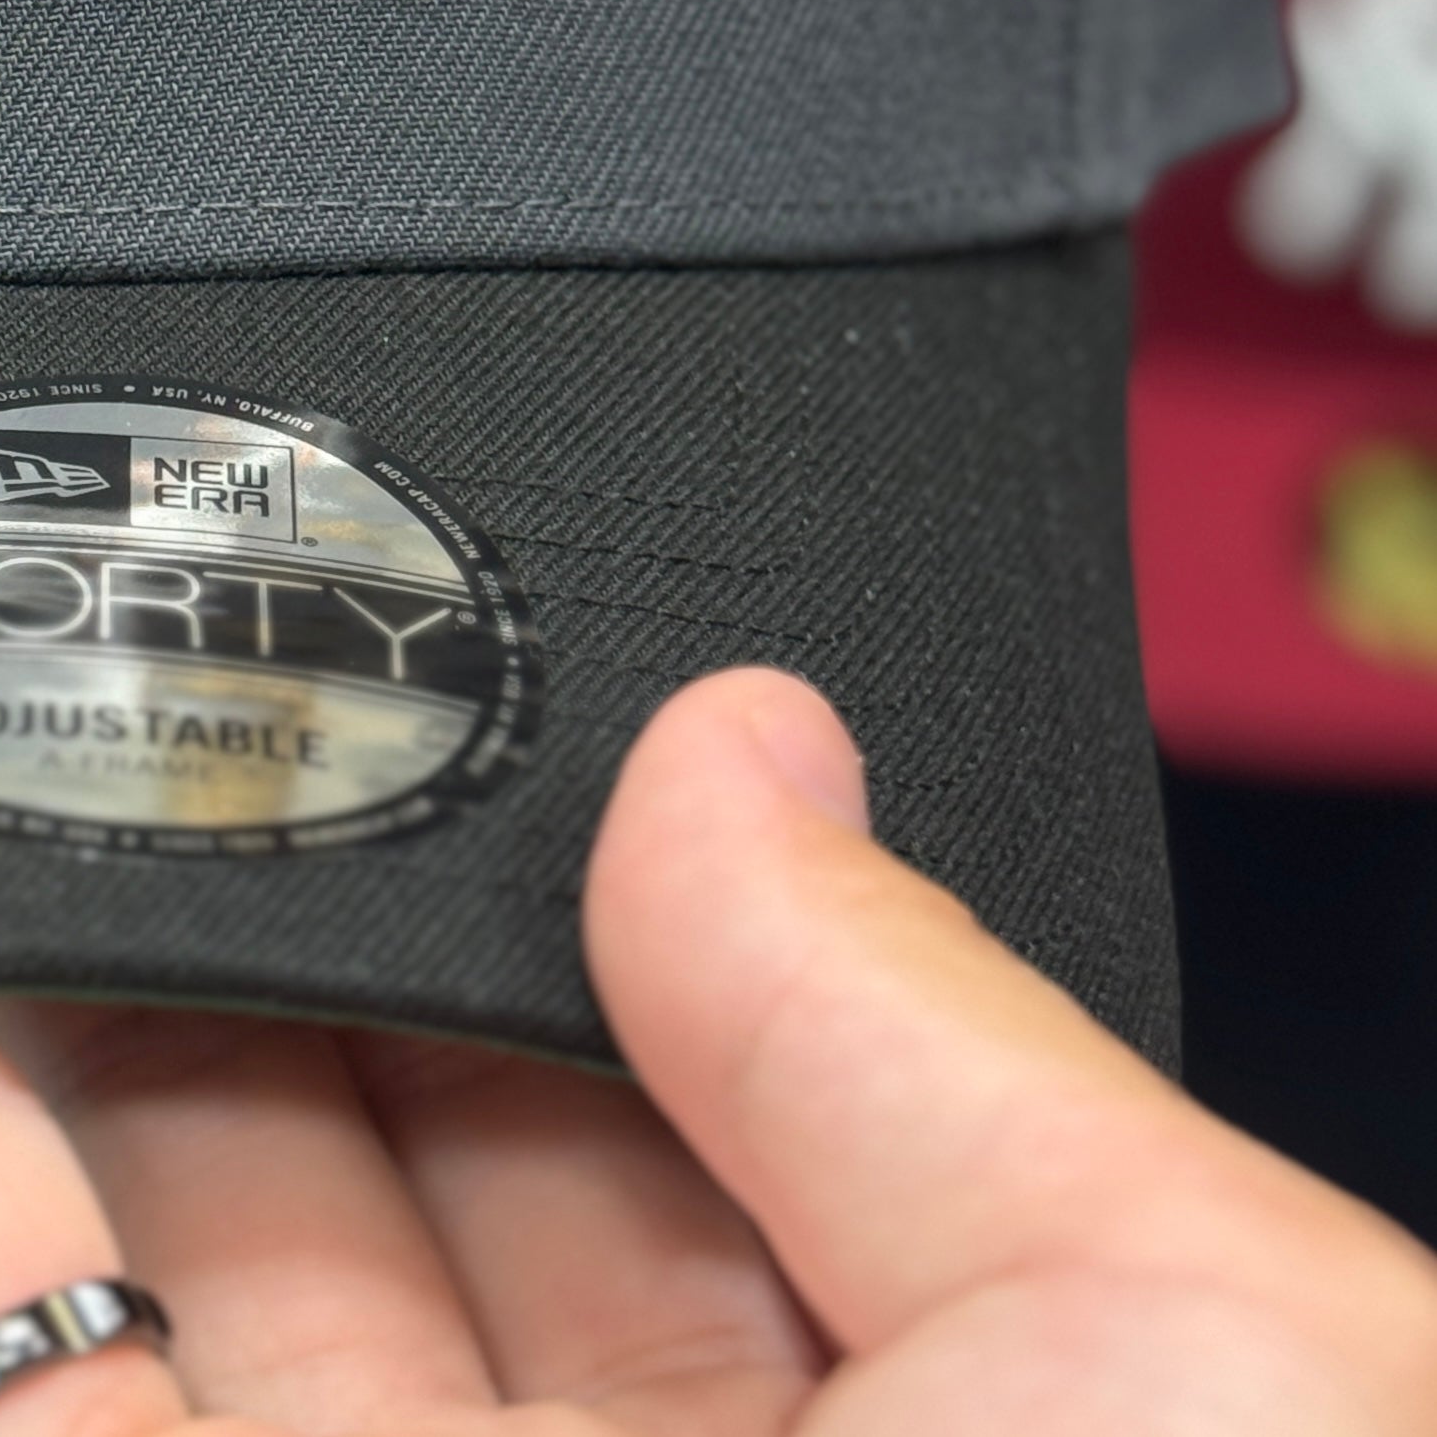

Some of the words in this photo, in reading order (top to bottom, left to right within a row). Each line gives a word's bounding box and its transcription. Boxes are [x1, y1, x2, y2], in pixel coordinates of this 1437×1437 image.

[50, 382, 104, 397] SINCE
[151, 385, 189, 400] USA
[234, 396, 315, 434] BUFFALO,
[153, 456, 269, 489] NEW
[153, 484, 271, 518] ERA
[373, 460, 482, 561] NEWERACAP.COM
